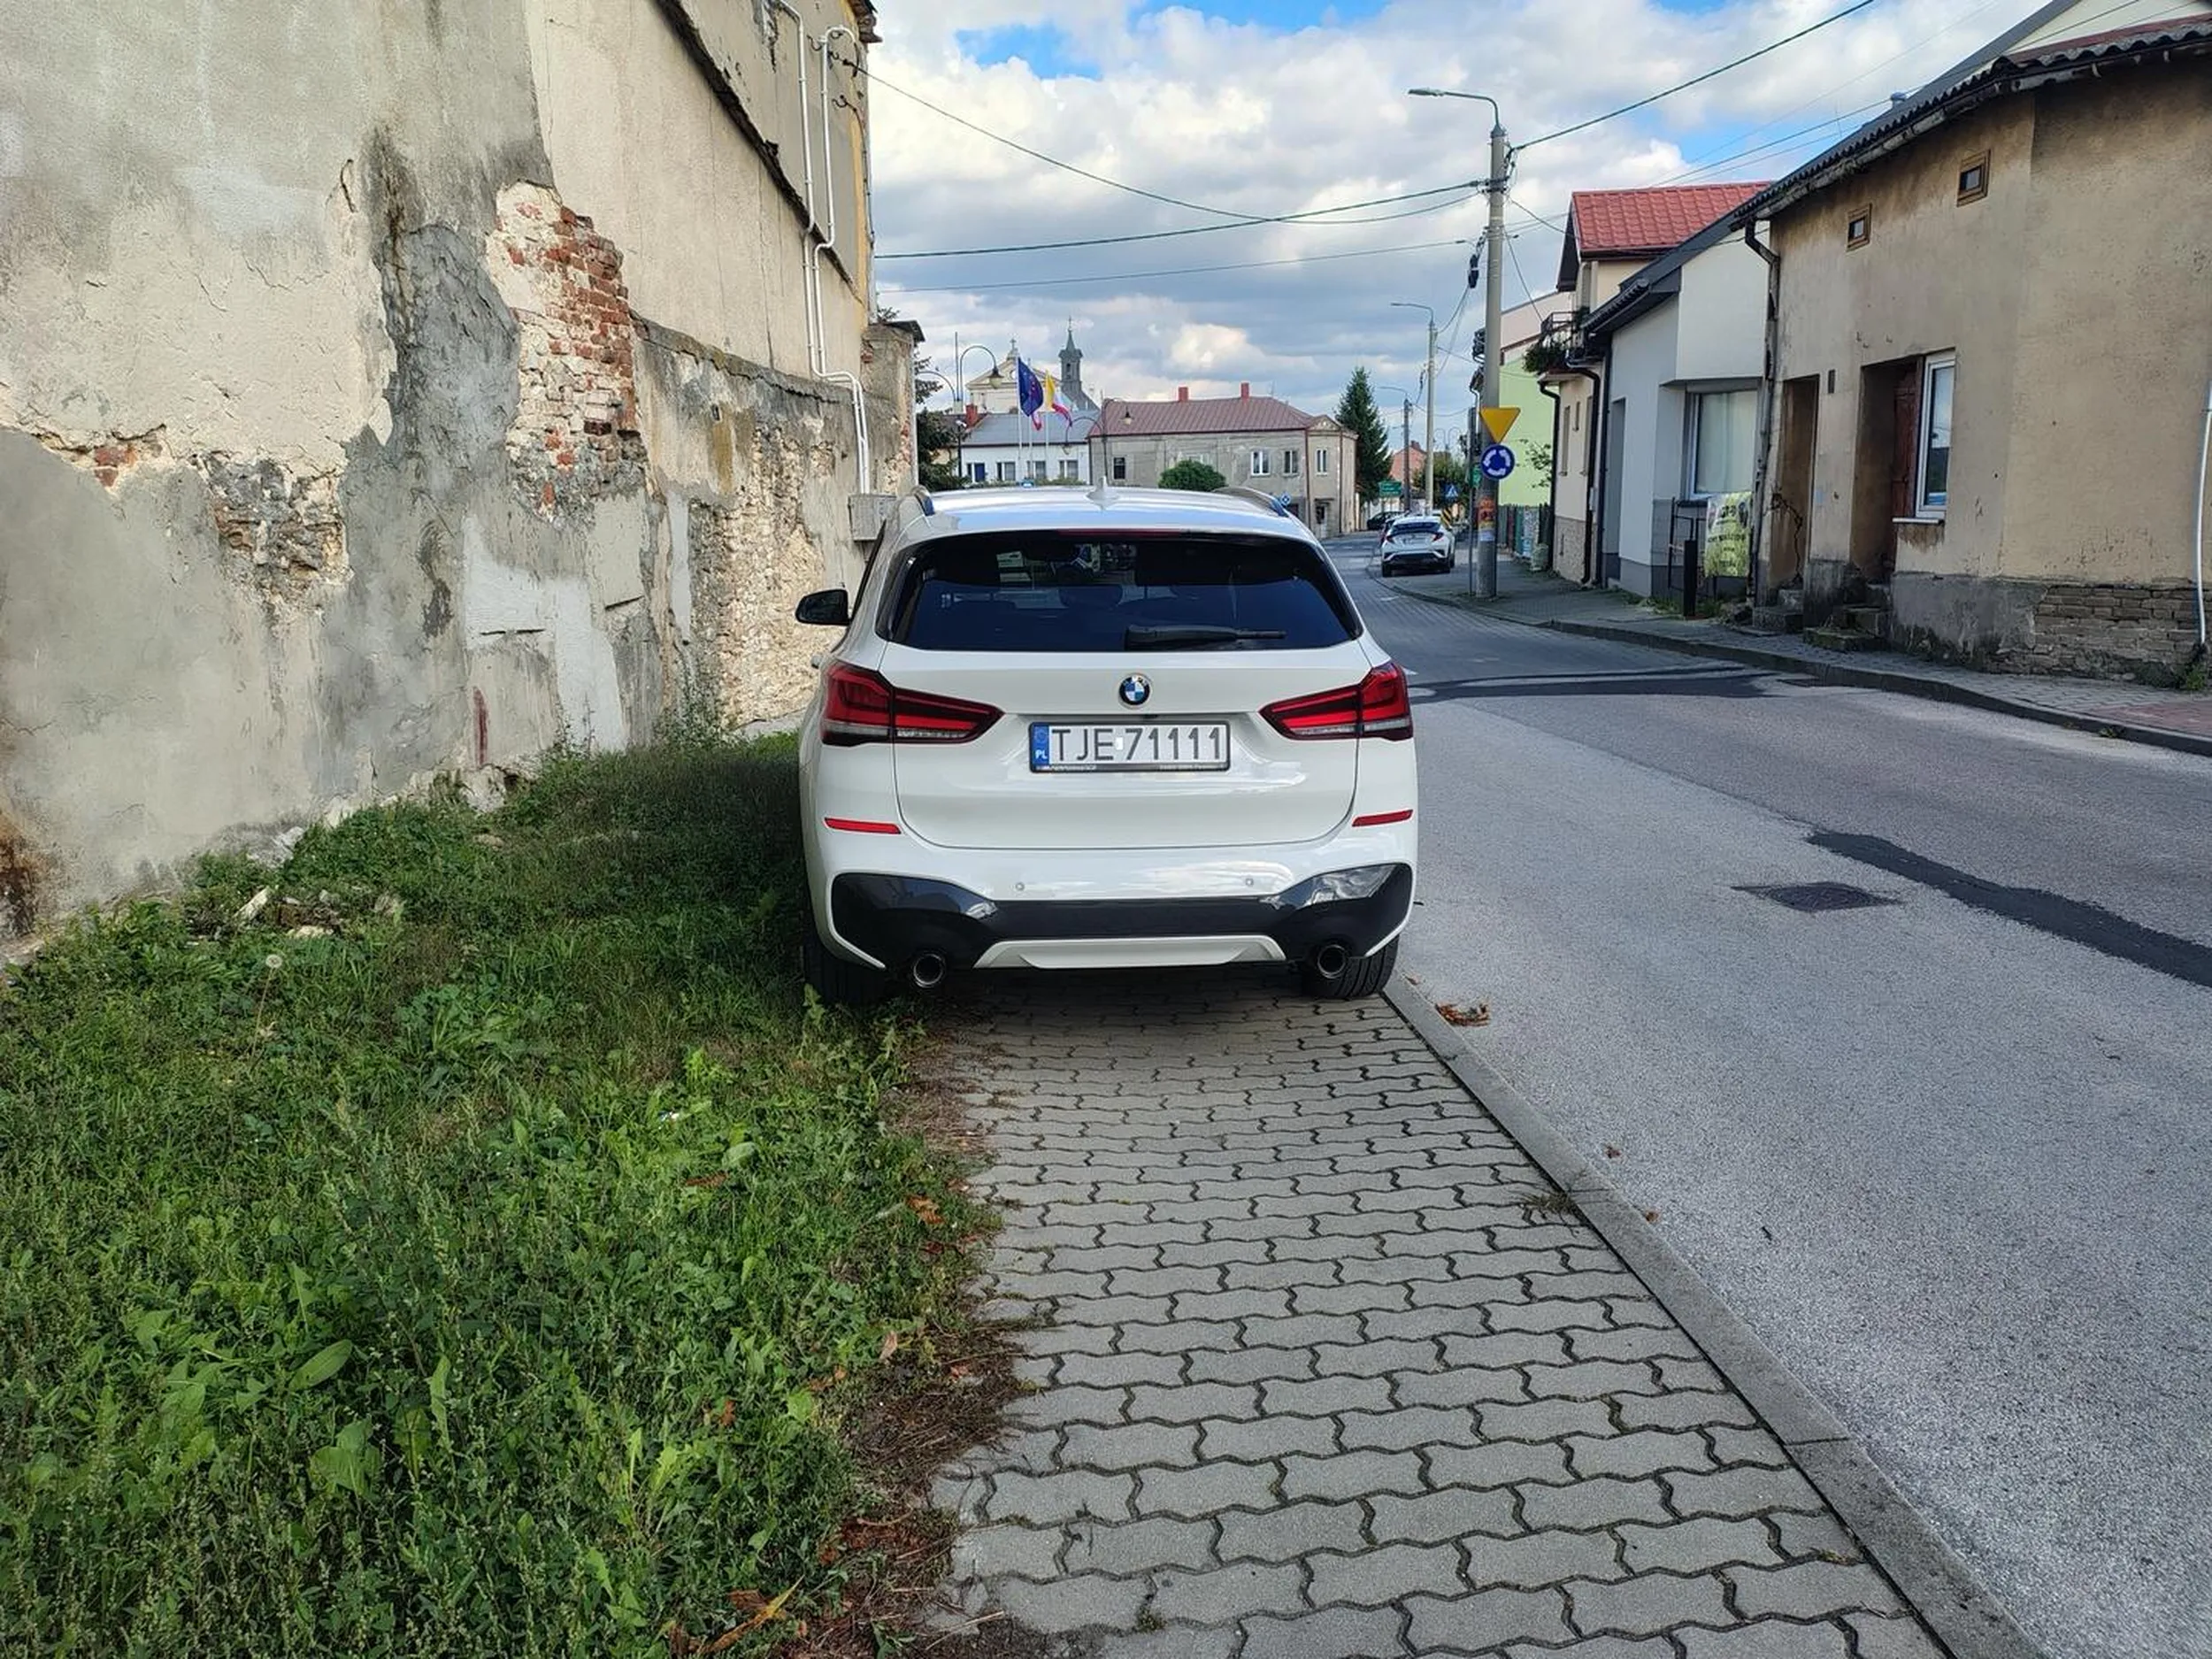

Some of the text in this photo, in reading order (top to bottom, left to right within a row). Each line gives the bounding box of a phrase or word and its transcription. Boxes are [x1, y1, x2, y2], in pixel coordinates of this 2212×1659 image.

[1034, 749, 1048, 759] PL
[1051, 727, 1220, 761] TJE 71111
